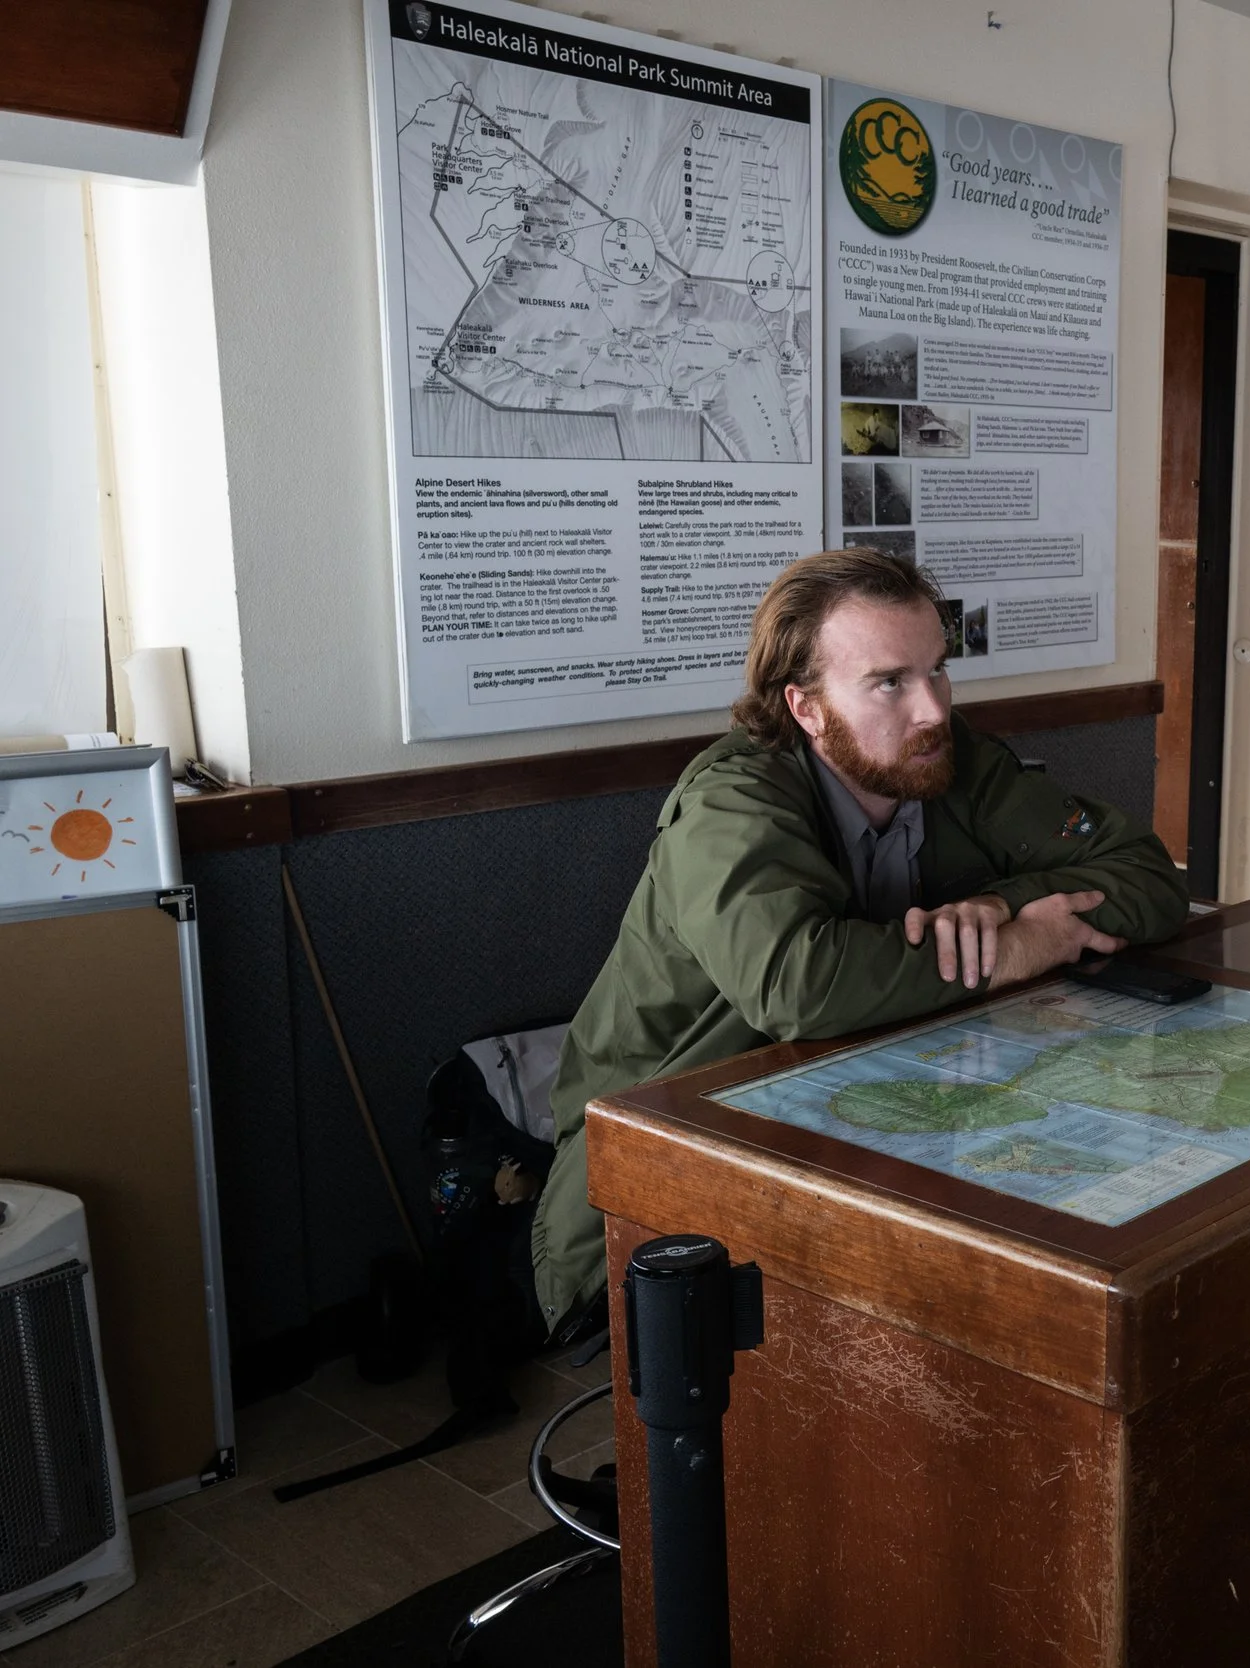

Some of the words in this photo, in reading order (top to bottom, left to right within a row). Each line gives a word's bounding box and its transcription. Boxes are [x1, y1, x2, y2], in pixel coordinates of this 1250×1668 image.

[441, 18, 538, 54] Haleakalā
[545, 41, 622, 72] National
[629, 59, 666, 82] Park
[671, 69, 733, 97] Summit
[738, 84, 772, 105] Area
[432, 143, 448, 151] Park
[859, 111, 920, 166] CCC
[459, 164, 482, 173] Center
[952, 180, 959, 199] I
[961, 182, 1018, 208] learned
[1020, 198, 1029, 211] a
[1032, 200, 1066, 217] good
[840, 241, 877, 256] Founded
[879, 246, 887, 257] in
[890, 248, 908, 260] 1933
[910, 250, 920, 264] by
[922, 252, 958, 266] President
[959, 258, 998, 272] Roosevelt,
[999, 263, 1010, 273] the
[1012, 265, 1039, 277] Civilian
[1039, 269, 1085, 283] Conservation
[1086, 276, 1106, 288] Corps
[843, 275, 852, 284] to
[854, 275, 878, 289] single
[879, 280, 905, 293] young
[906, 284, 926, 292] men.
[928, 283, 949, 295] From
[951, 286, 980, 298] 1934-41
[981, 292, 1007, 302] several
[1008, 293, 1026, 304] CCC
[1026, 298, 1047, 306] crews
[1065, 302, 1095, 312] stationed
[876, 264, 893, 273] was
[900, 265, 919, 276] New
[919, 267, 938, 279] Deal
[940, 273, 972, 284] program
[974, 274, 989, 285] that
[990, 279, 1022, 289] provided
[1024, 283, 1066, 295] employment
[1067, 288, 1080, 297] and
[1081, 290, 1107, 302] training
[519, 298, 565, 308] WILDERNESS
[879, 293, 914, 306] National
[916, 297, 934, 308] Park
[936, 300, 960, 311] (made
[962, 305, 971, 314] up
[973, 304, 981, 313] of
[1030, 310, 1048, 320] Maui
[1049, 313, 1062, 322] and
[1089, 318, 1101, 326] and
[483, 334, 506, 342] Center
[859, 306, 888, 318] Mauna
[890, 309, 906, 320] Loa
[920, 312, 932, 323] the
[934, 314, 946, 327] Big
[948, 315, 976, 328] Island).
[977, 318, 992, 329] The
[993, 322, 1032, 333] experience
[1047, 325, 1058, 336] life
[1059, 327, 1090, 341] changing.
[416, 479, 443, 488] Alpine
[446, 479, 475, 487] Desert
[477, 479, 501, 487] Hikes
[416, 500, 442, 508] plants,
[473, 672, 492, 680] Bring
[494, 670, 515, 679] water,
[518, 667, 554, 678] sunscreen,
[571, 663, 595, 673] snacks.
